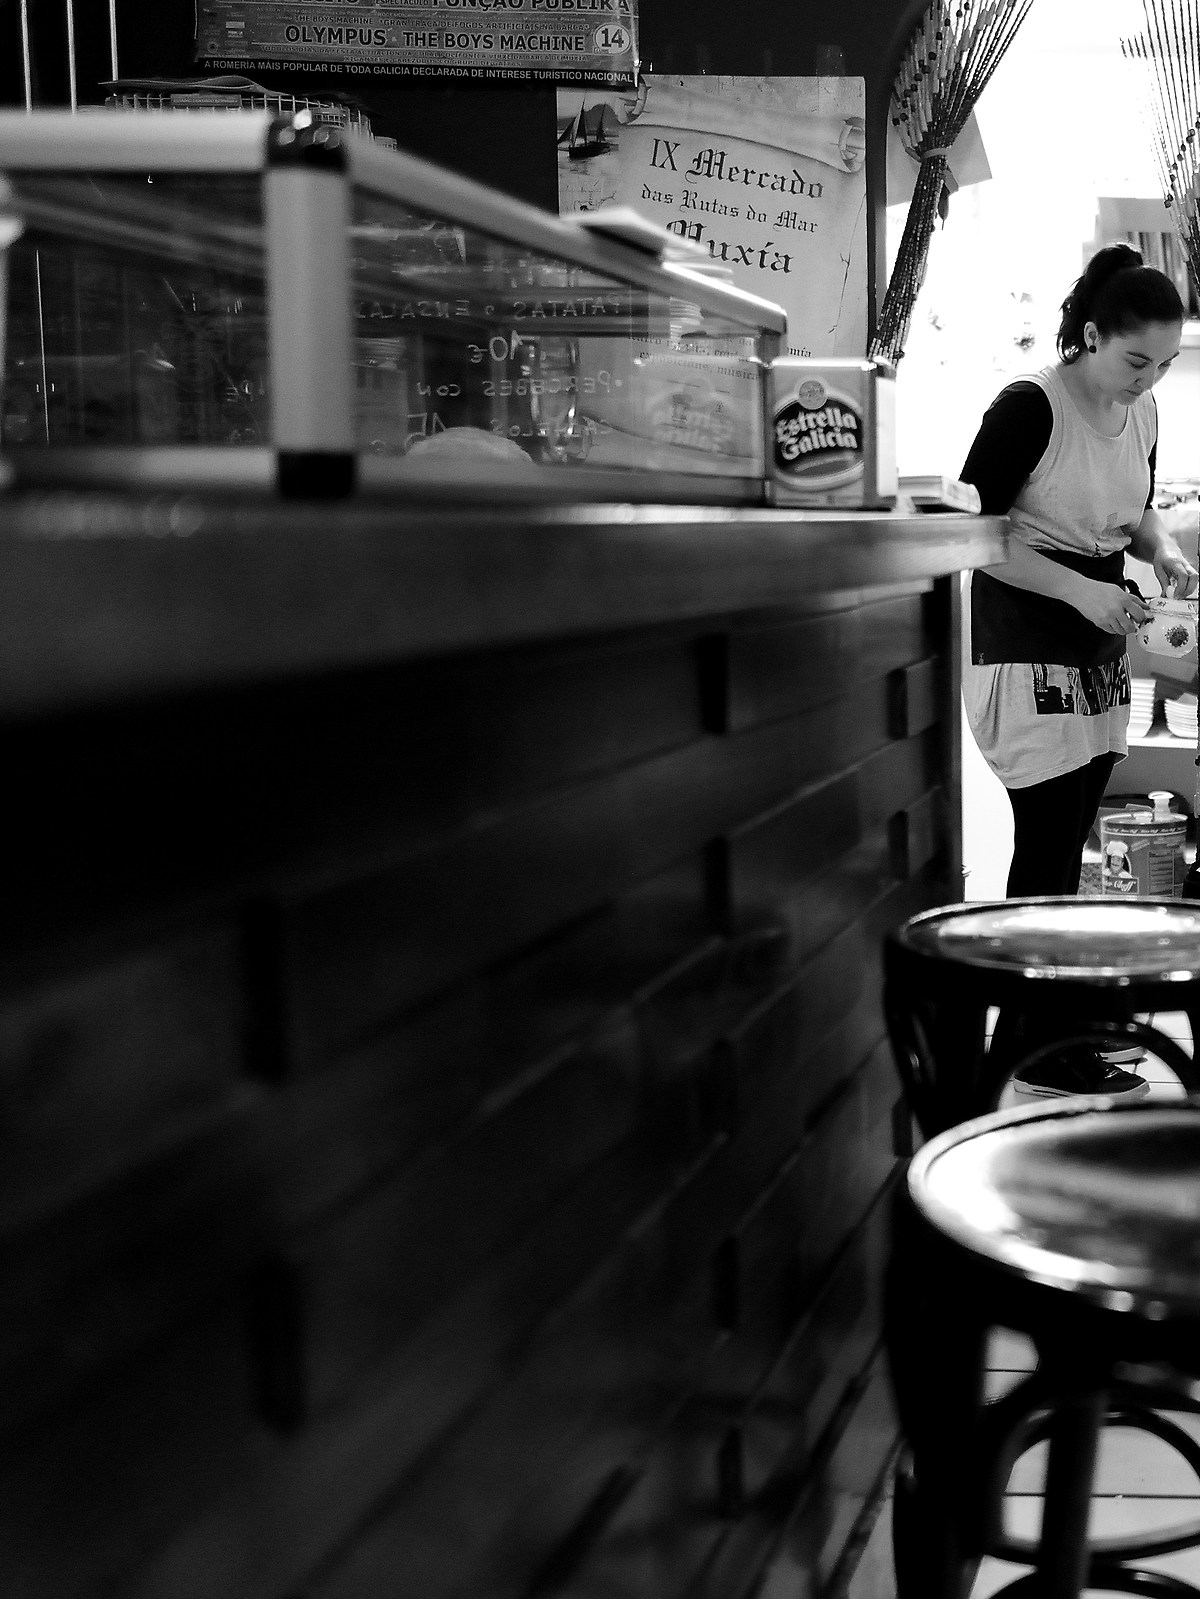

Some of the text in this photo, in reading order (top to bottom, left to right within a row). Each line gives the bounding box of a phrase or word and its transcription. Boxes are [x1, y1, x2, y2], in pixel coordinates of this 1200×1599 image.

[284, 24, 586, 52] OLYMPUS THE BOYS MACHINE
[601, 27, 624, 49] 14
[204, 61, 211, 69] A
[283, 62, 328, 72] POPULAR
[330, 64, 343, 73] DE
[345, 65, 371, 74] TODA
[373, 66, 410, 76] GALICIA
[412, 67, 469, 77] DECLARADA
[471, 68, 484, 78] DE
[486, 69, 532, 79] INTERESE
[584, 71, 633, 83] NACIONAL
[649, 138, 825, 200] IX Mercado
[641, 183, 819, 234] das Rutas do Mar
[665, 219, 794, 275] Muxía
[776, 406, 858, 444] Estrella
[781, 426, 858, 461] Galicia
